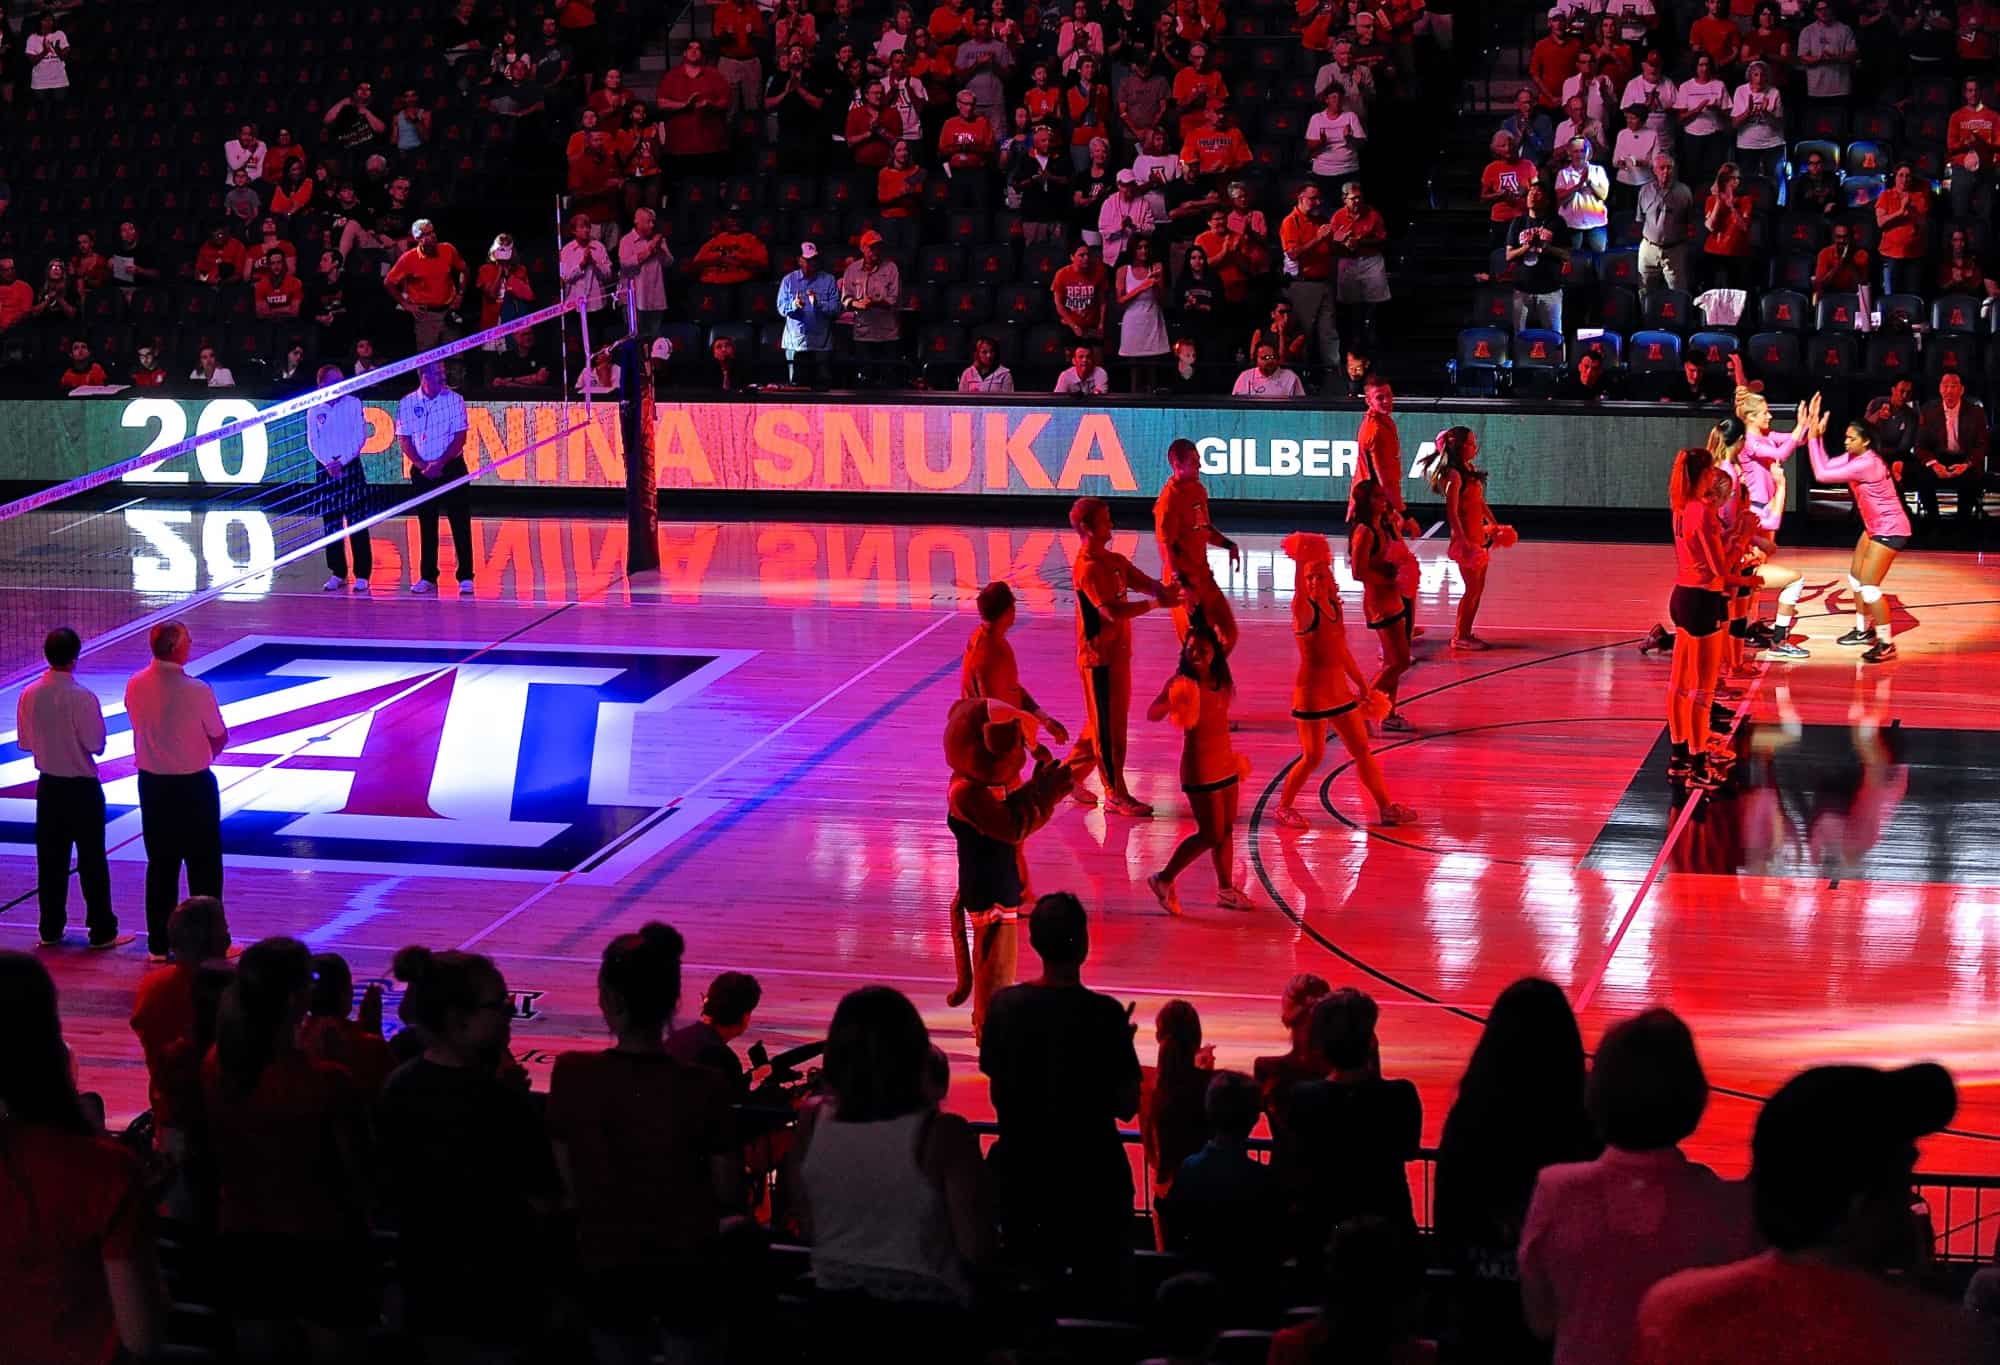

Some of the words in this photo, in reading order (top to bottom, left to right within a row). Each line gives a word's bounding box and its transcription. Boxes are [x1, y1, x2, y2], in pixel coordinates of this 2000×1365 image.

[1065, 285, 1095, 297] BEAR
[120, 398, 268, 484] 20
[358, 404, 716, 490] PNINA
[753, 408, 1139, 492] SNUKA
[1196, 437, 1360, 482] GILBER
